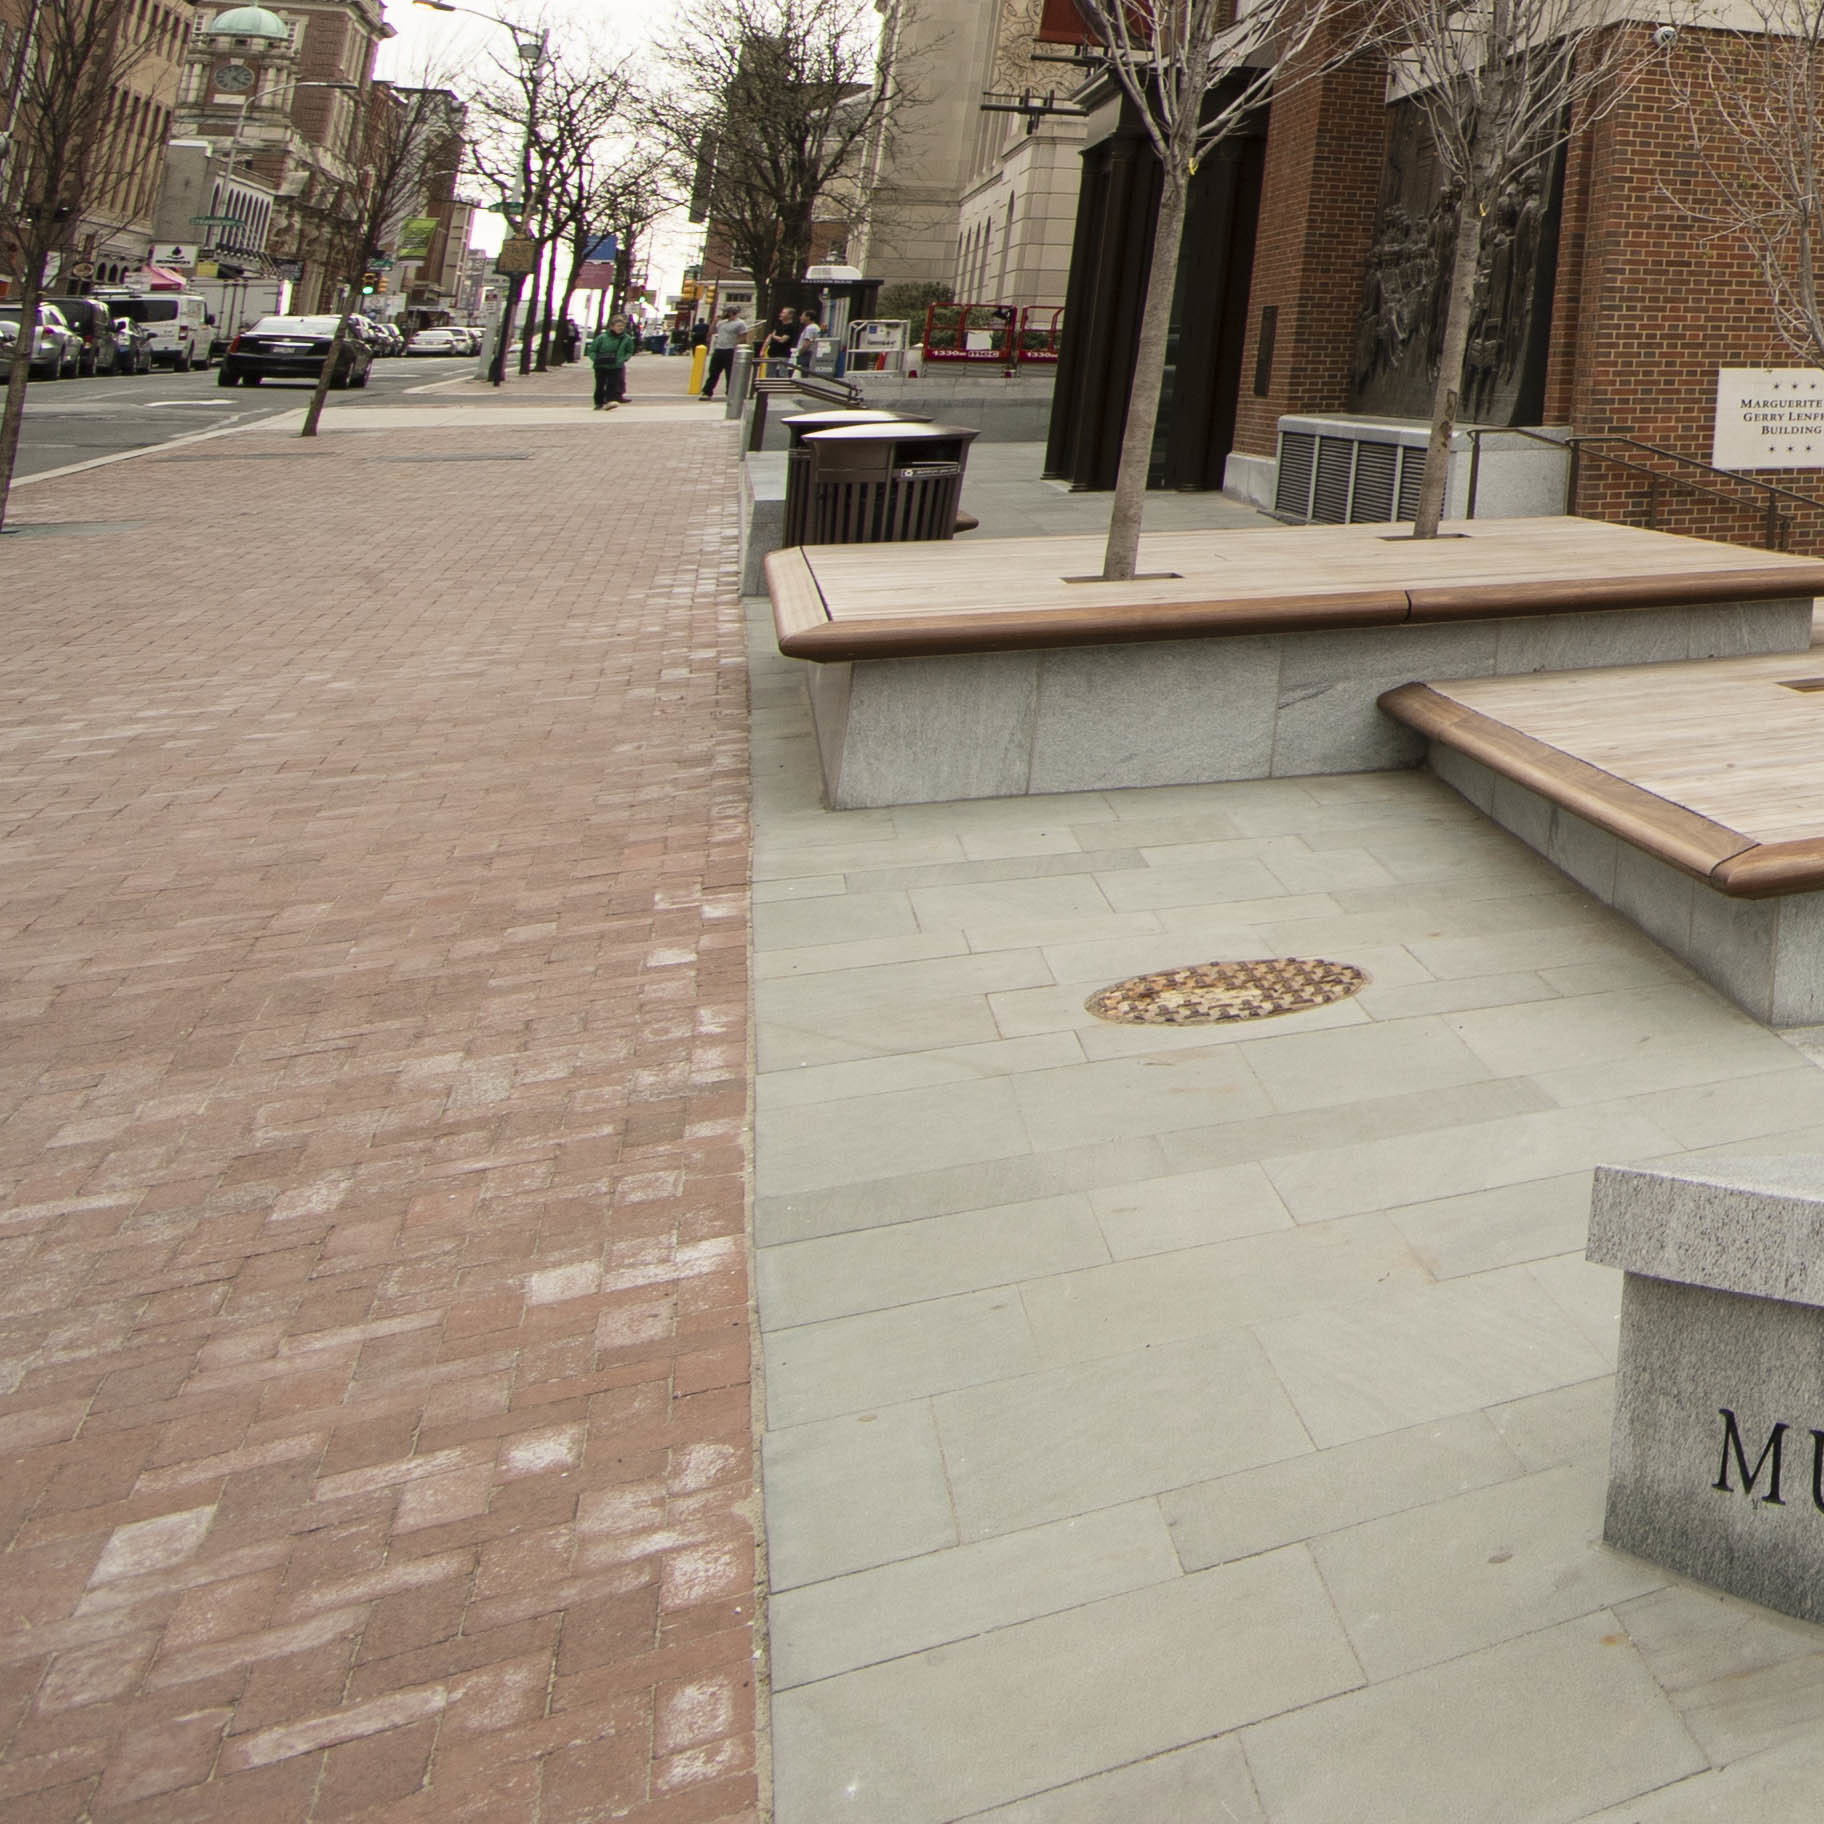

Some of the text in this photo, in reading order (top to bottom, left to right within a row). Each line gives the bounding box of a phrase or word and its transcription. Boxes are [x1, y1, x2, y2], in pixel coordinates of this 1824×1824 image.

[1740, 399, 1822, 408] MARGUERITE
[1743, 412, 1785, 422] GERRY
[1761, 425, 1822, 435] BUILDING
